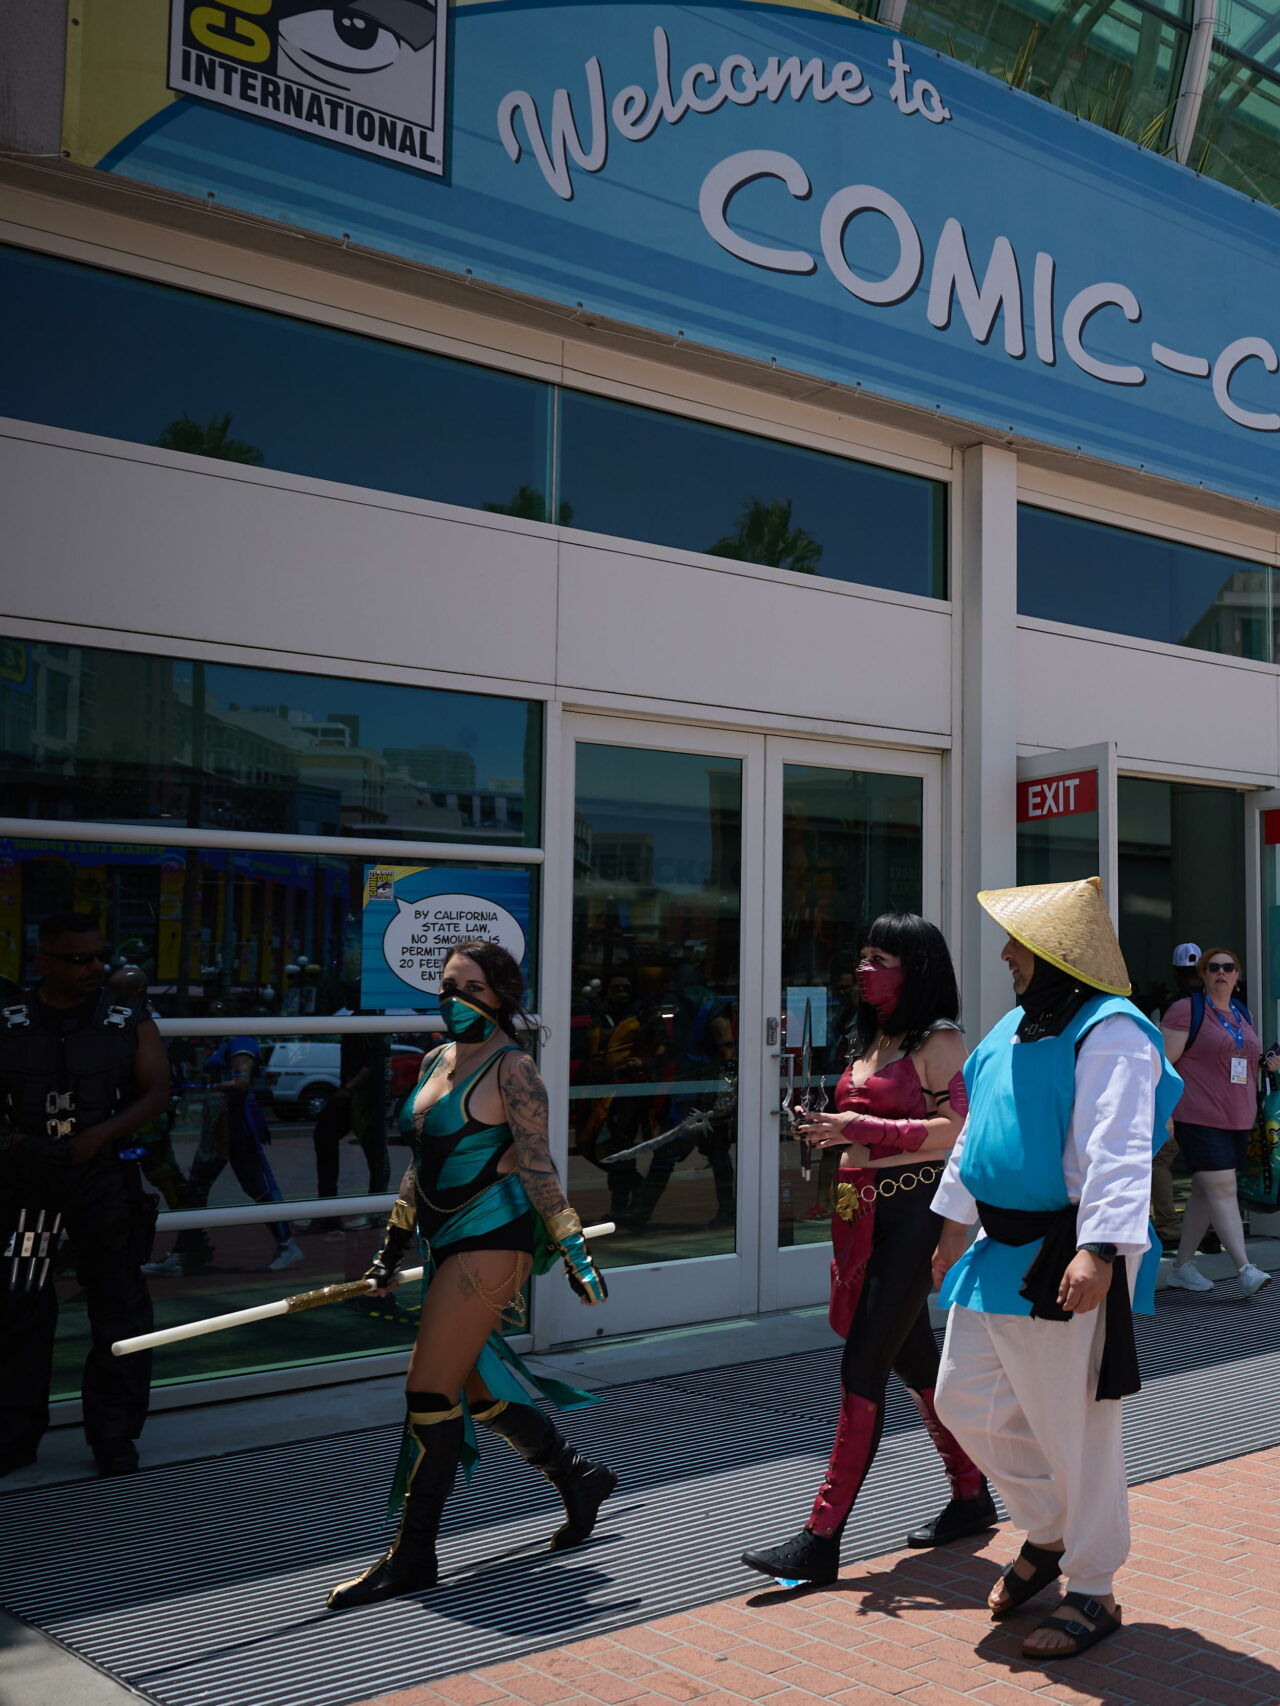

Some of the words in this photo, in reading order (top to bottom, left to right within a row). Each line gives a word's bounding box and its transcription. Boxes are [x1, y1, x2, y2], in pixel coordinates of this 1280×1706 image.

[181, 47, 437, 164] INTERNATIONAL
[496, 25, 872, 200] Welcome
[887, 39, 952, 124] to
[1028, 778, 1079, 818] EXIT
[414, 910, 429, 919] BY
[434, 910, 498, 921] CALIFORNIA
[422, 922, 461, 932] STATE
[465, 923, 491, 934] LAW,
[411, 934, 428, 944] NO
[488, 935, 500, 944] IS
[399, 959, 414, 968] 20
